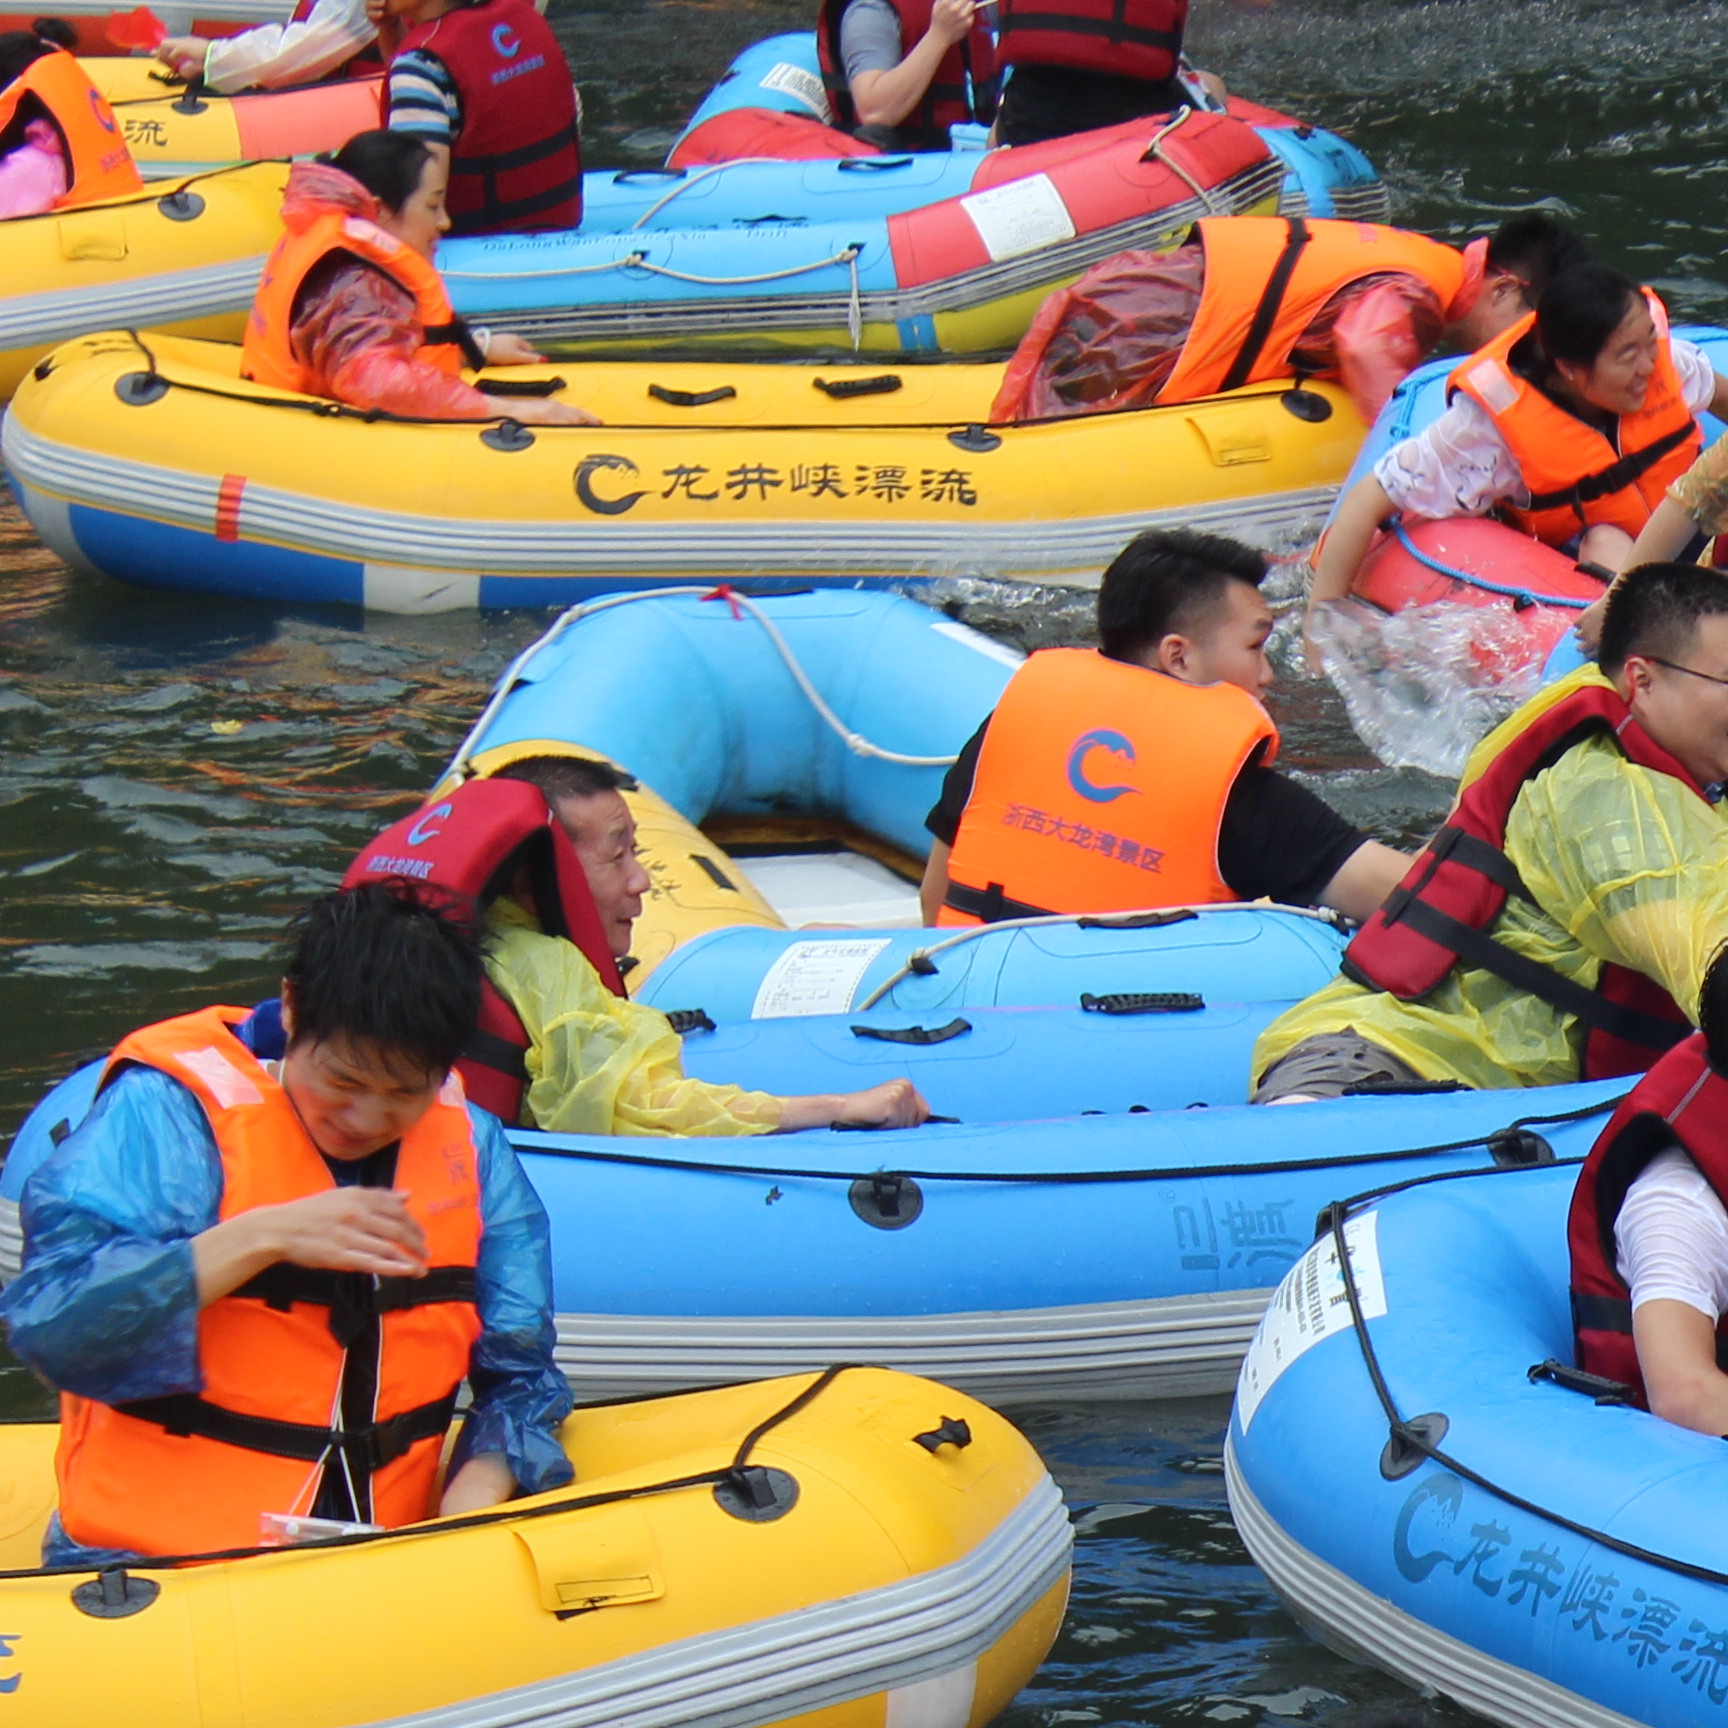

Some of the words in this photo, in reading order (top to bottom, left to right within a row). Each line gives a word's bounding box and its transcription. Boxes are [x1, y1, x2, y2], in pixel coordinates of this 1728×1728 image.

[661, 463, 976, 506] 龙井峡漂流
[1001, 802, 1166, 874] 浙西大龙湾景区
